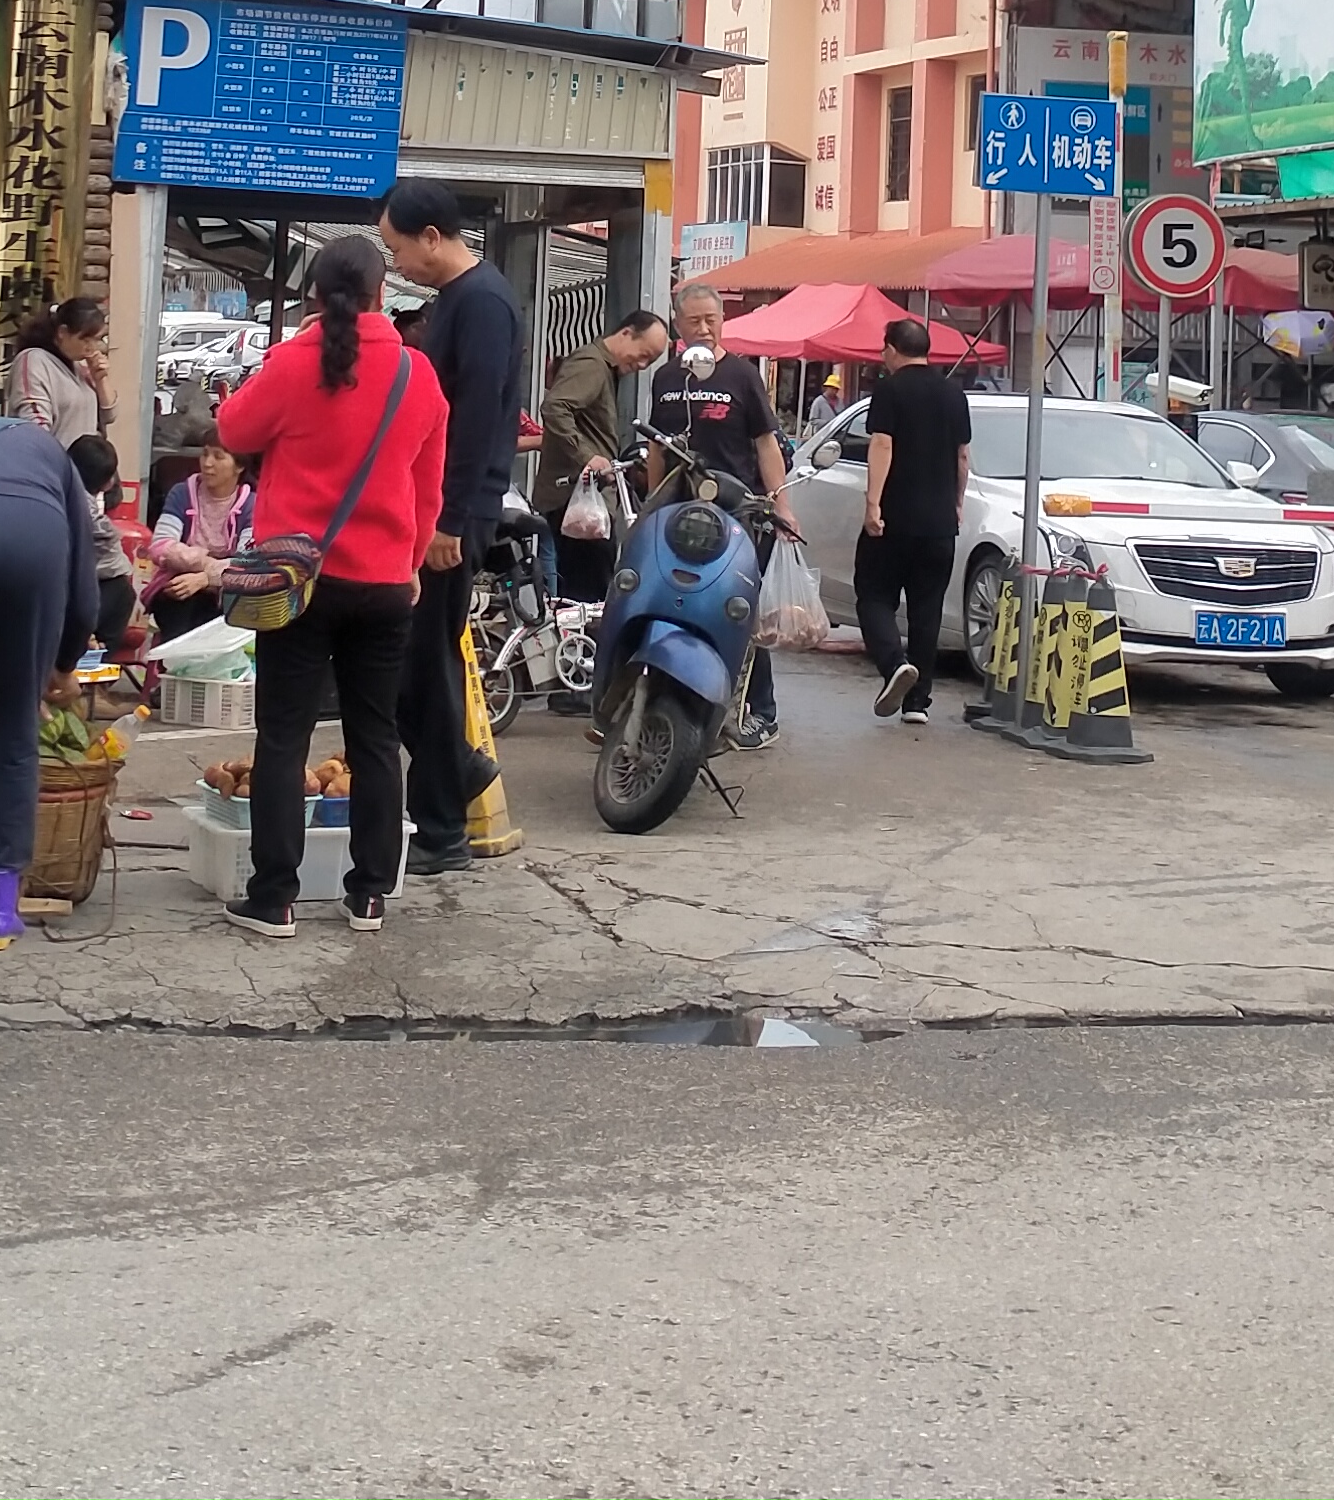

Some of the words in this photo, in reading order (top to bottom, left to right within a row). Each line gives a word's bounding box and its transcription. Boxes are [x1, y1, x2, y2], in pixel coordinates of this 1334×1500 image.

[134, 6, 212, 107] P
[820, 35, 839, 63] 自由
[818, 86, 838, 112] 公正
[985, 130, 1038, 167] 行人
[1051, 134, 1113, 172] 机动车
[1162, 223, 1198, 269] 5
